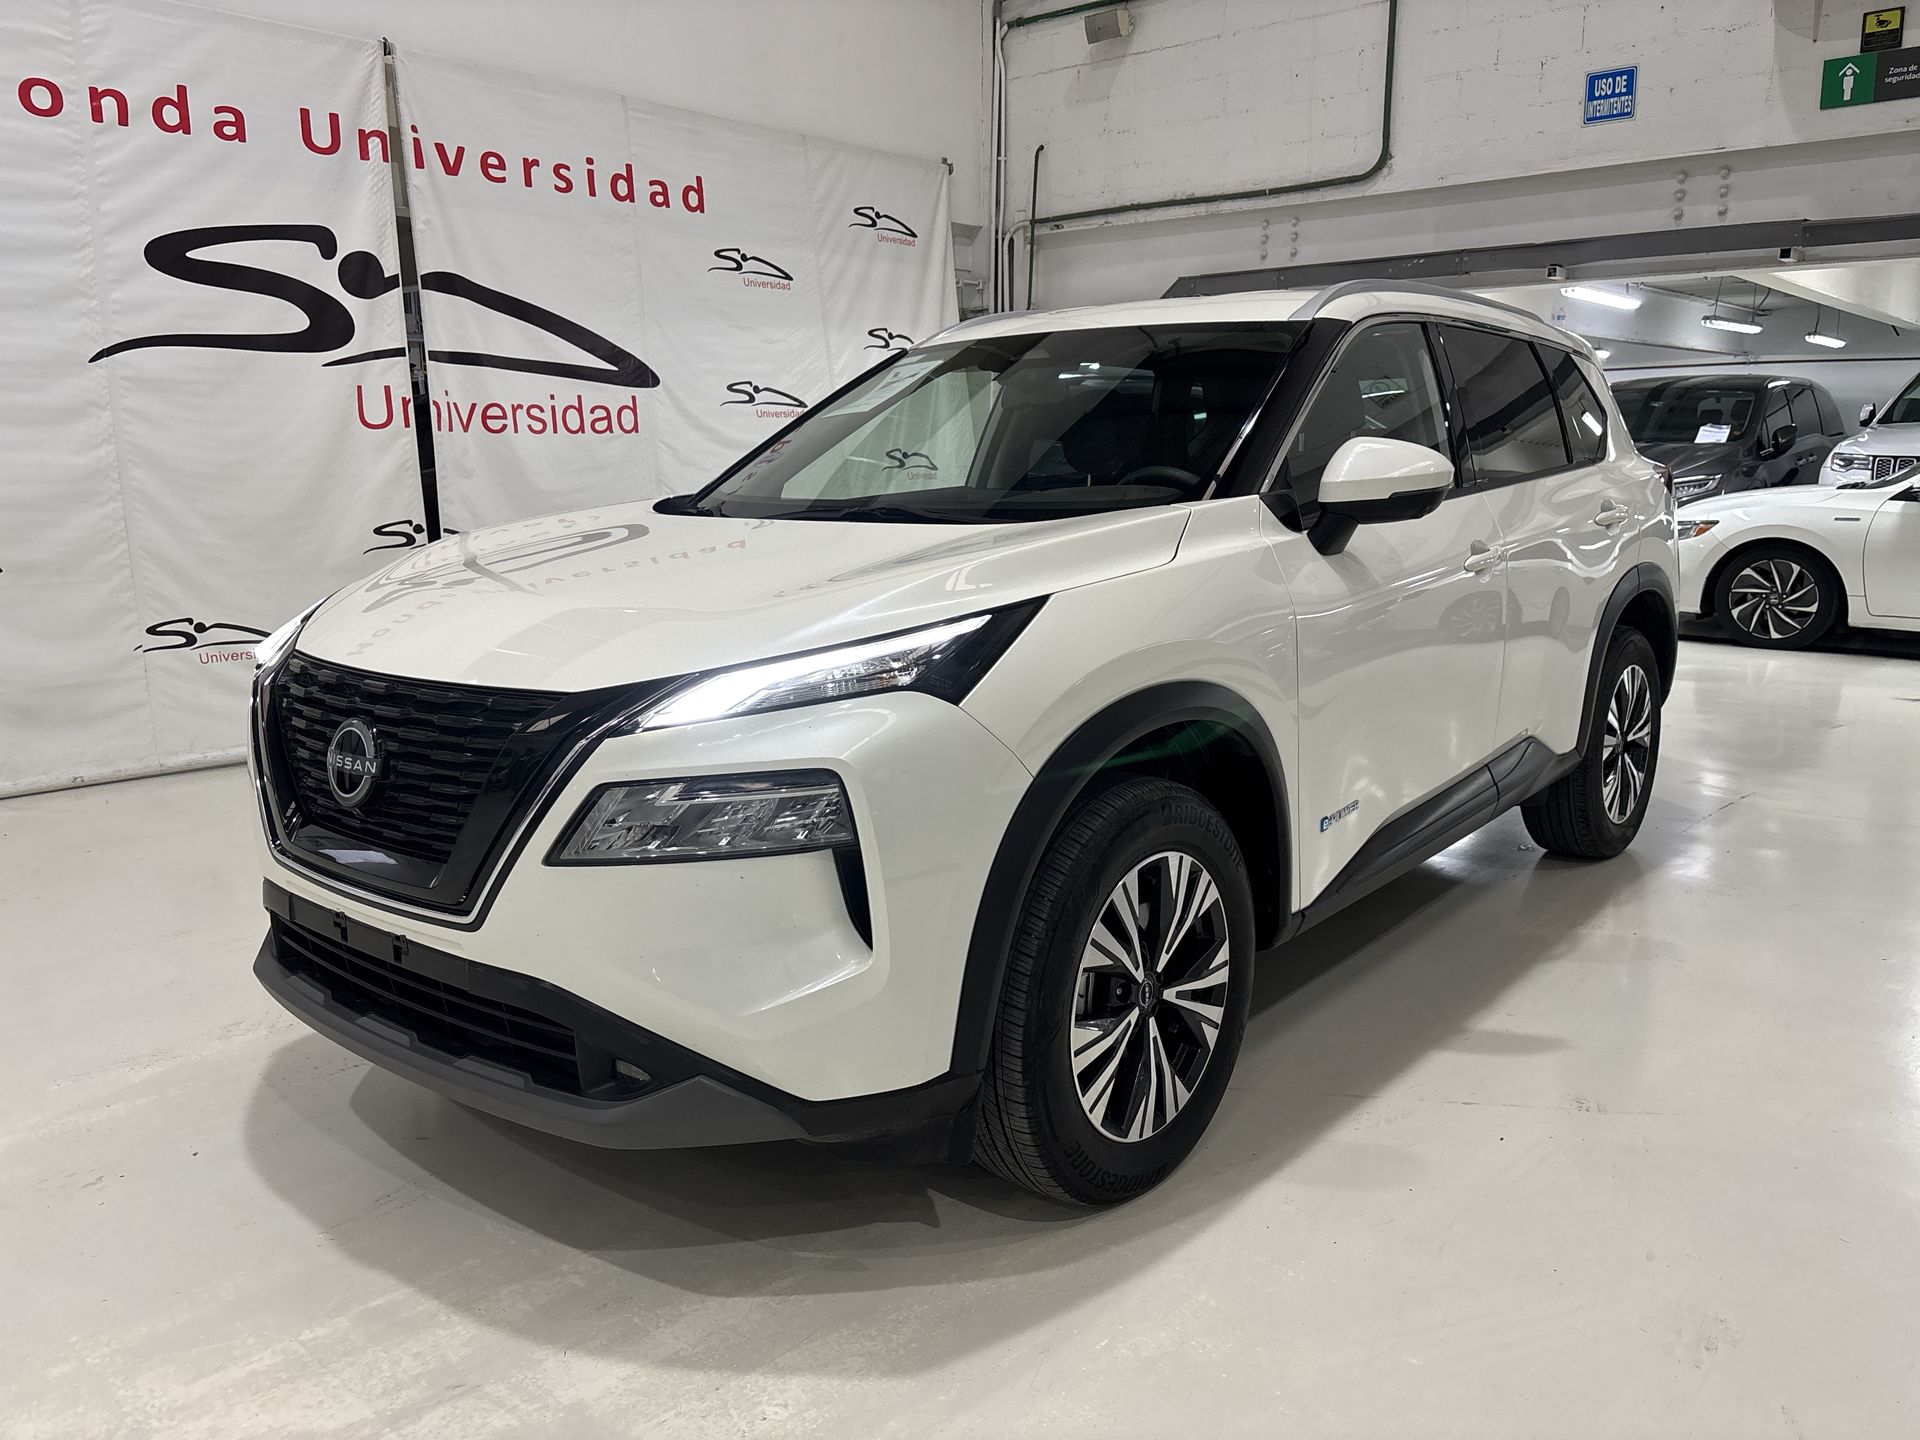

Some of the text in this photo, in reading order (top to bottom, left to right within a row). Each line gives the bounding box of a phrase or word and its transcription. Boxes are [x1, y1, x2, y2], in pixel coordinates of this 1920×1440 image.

[1888, 64, 1919, 75] Zona de
[1594, 75, 1628, 97] USO DE
[299, 107, 706, 215] Universidad
[877, 233, 916, 247] Universidad
[743, 277, 791, 291] Universidad
[356, 384, 640, 435] Universidad
[199, 649, 257, 664] Universi
[327, 749, 377, 774] NISSAN
